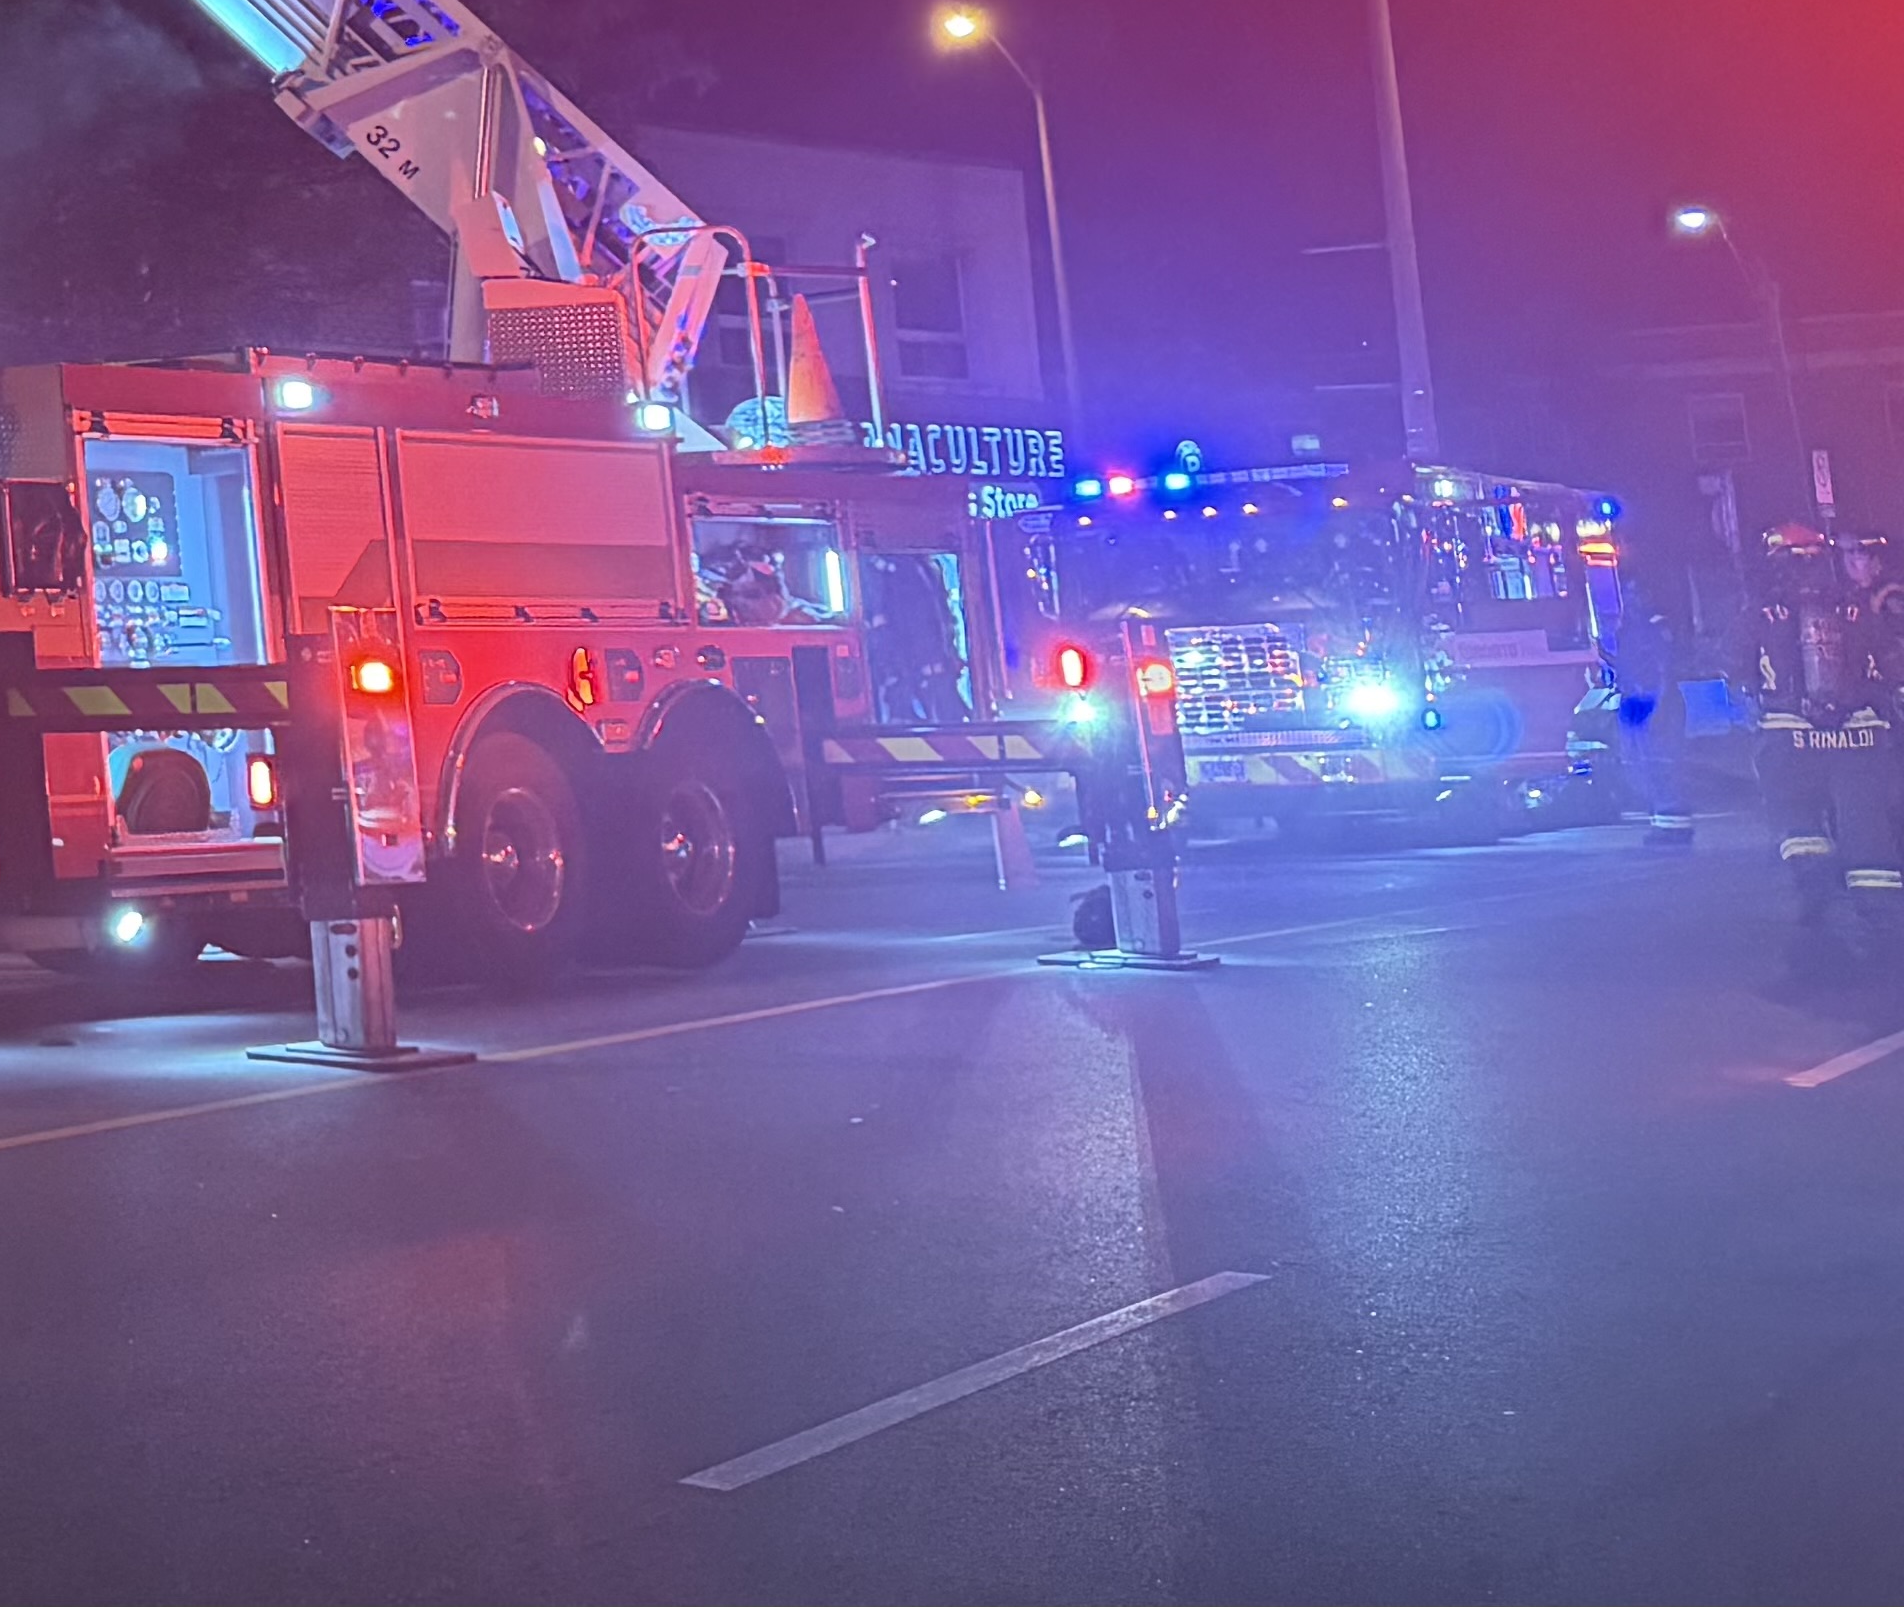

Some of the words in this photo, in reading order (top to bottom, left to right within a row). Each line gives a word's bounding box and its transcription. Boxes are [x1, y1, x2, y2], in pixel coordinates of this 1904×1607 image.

[366, 125, 401, 160] 32
[398, 159, 420, 180] M
[1793, 730, 1806, 749] S
[1809, 729, 1874, 749] RINALDI
